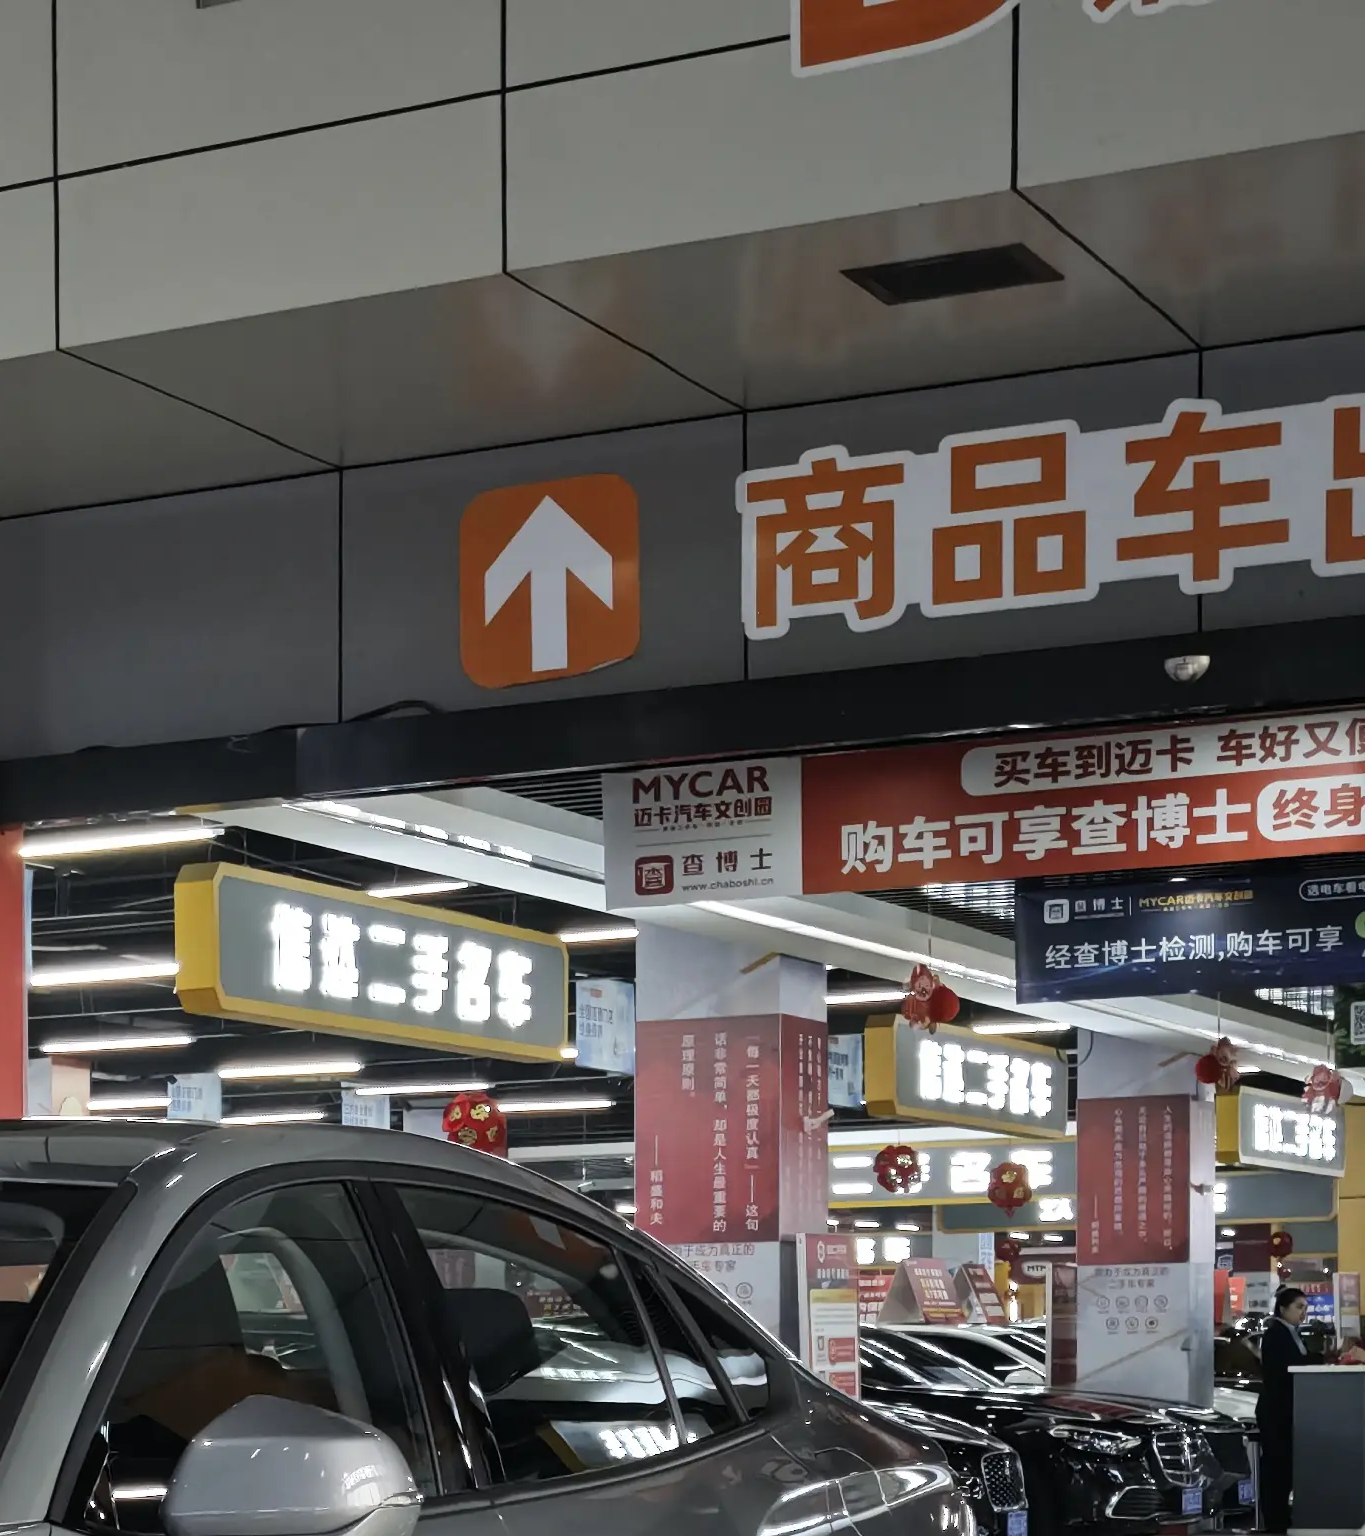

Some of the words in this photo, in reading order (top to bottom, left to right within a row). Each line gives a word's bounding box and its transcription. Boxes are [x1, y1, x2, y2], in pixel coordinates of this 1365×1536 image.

[746, 408, 1365, 629] 商品车
[632, 765, 770, 804] MYCAR
[994, 736, 1196, 788] 买车到迈卡
[634, 796, 772, 827] 迈卡汽车文创园
[840, 788, 1252, 876] 购车可享查博士
[681, 877, 775, 892] www.chaboshi.cn
